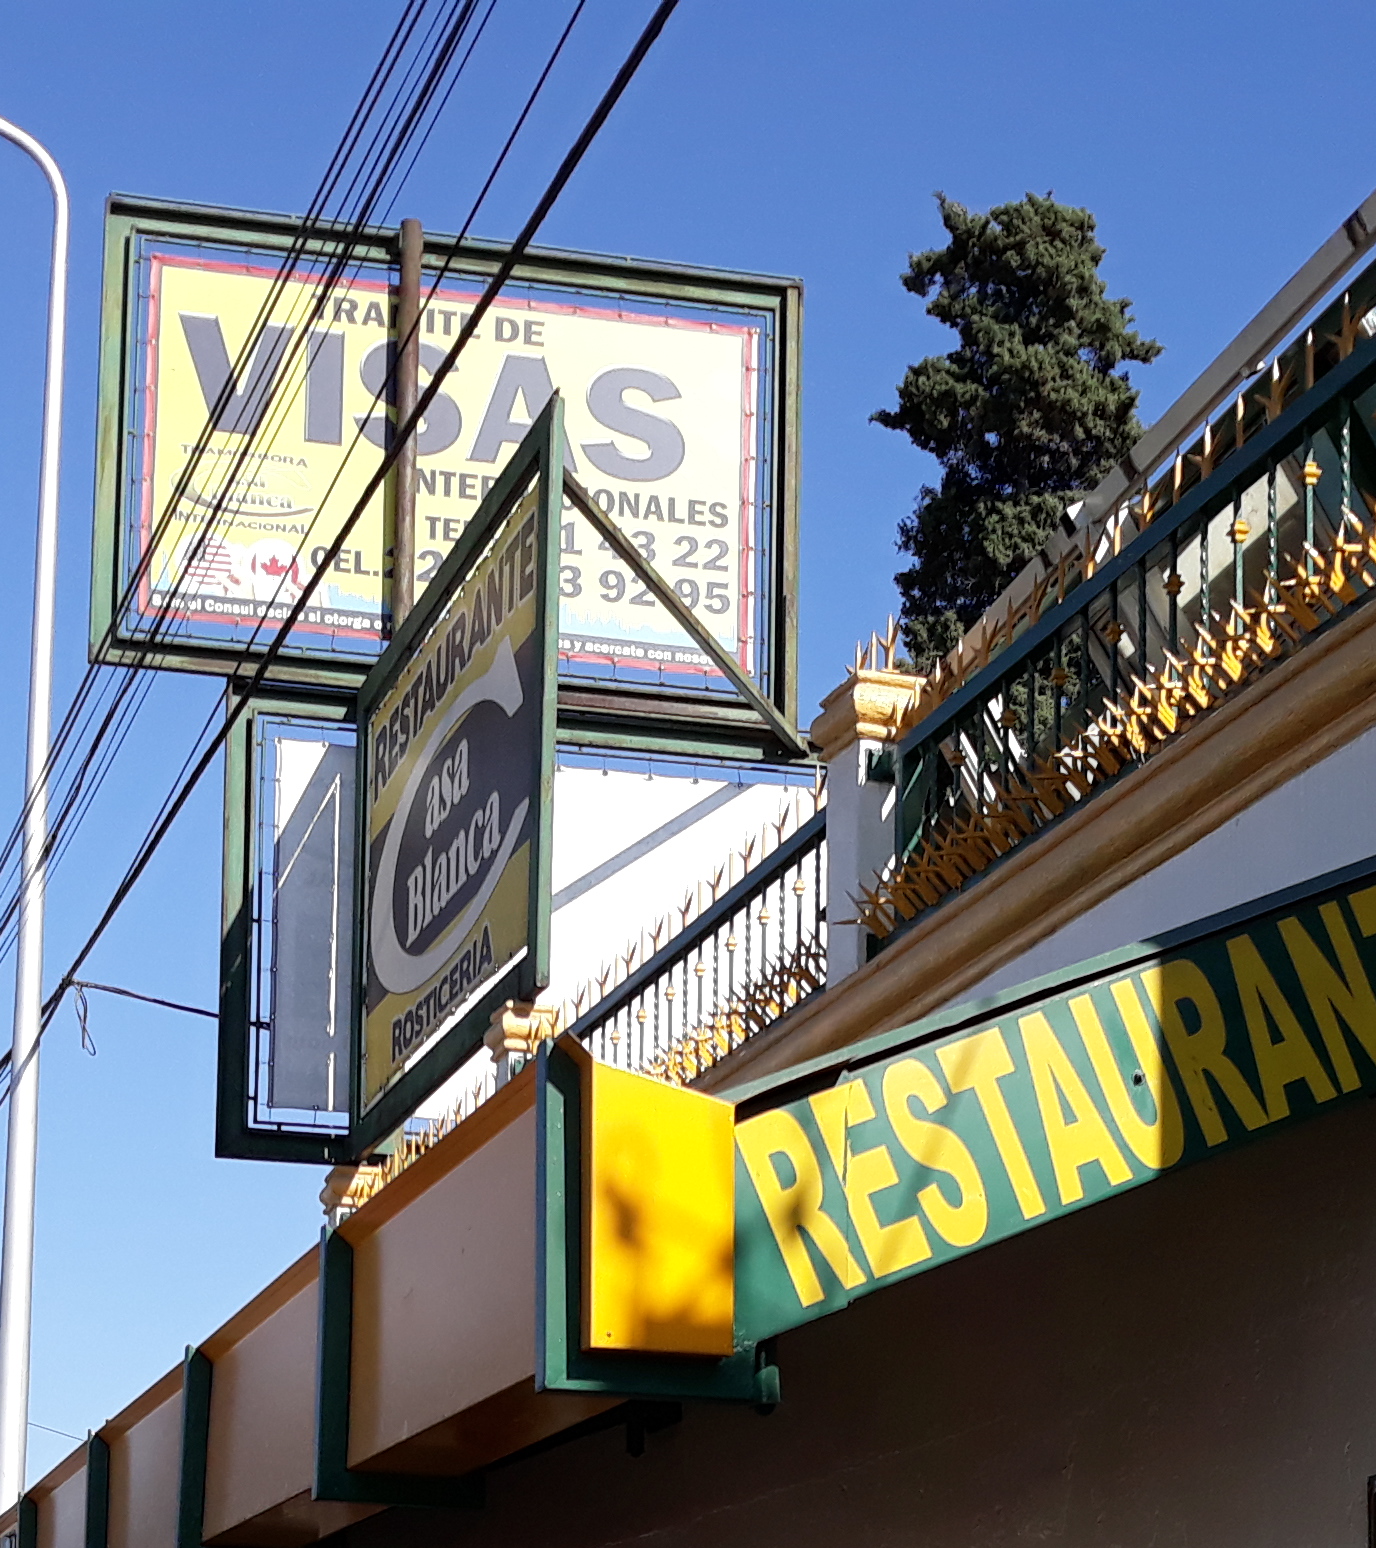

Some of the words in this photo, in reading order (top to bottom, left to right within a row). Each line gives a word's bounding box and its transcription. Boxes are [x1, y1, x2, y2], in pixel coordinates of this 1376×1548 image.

[495, 315, 546, 347] DE
[178, 312, 686, 482] VISAS
[311, 545, 379, 577] CEL.
[599, 570, 656, 608] 92
[673, 578, 730, 614] 95
[672, 536, 730, 572] 22
[324, 614, 372, 630] otorga
[373, 506, 536, 804] RESTAURANTE
[648, 650, 671, 662] con
[406, 788, 502, 949] Blanca
[391, 924, 493, 1064] ROSTICERIA
